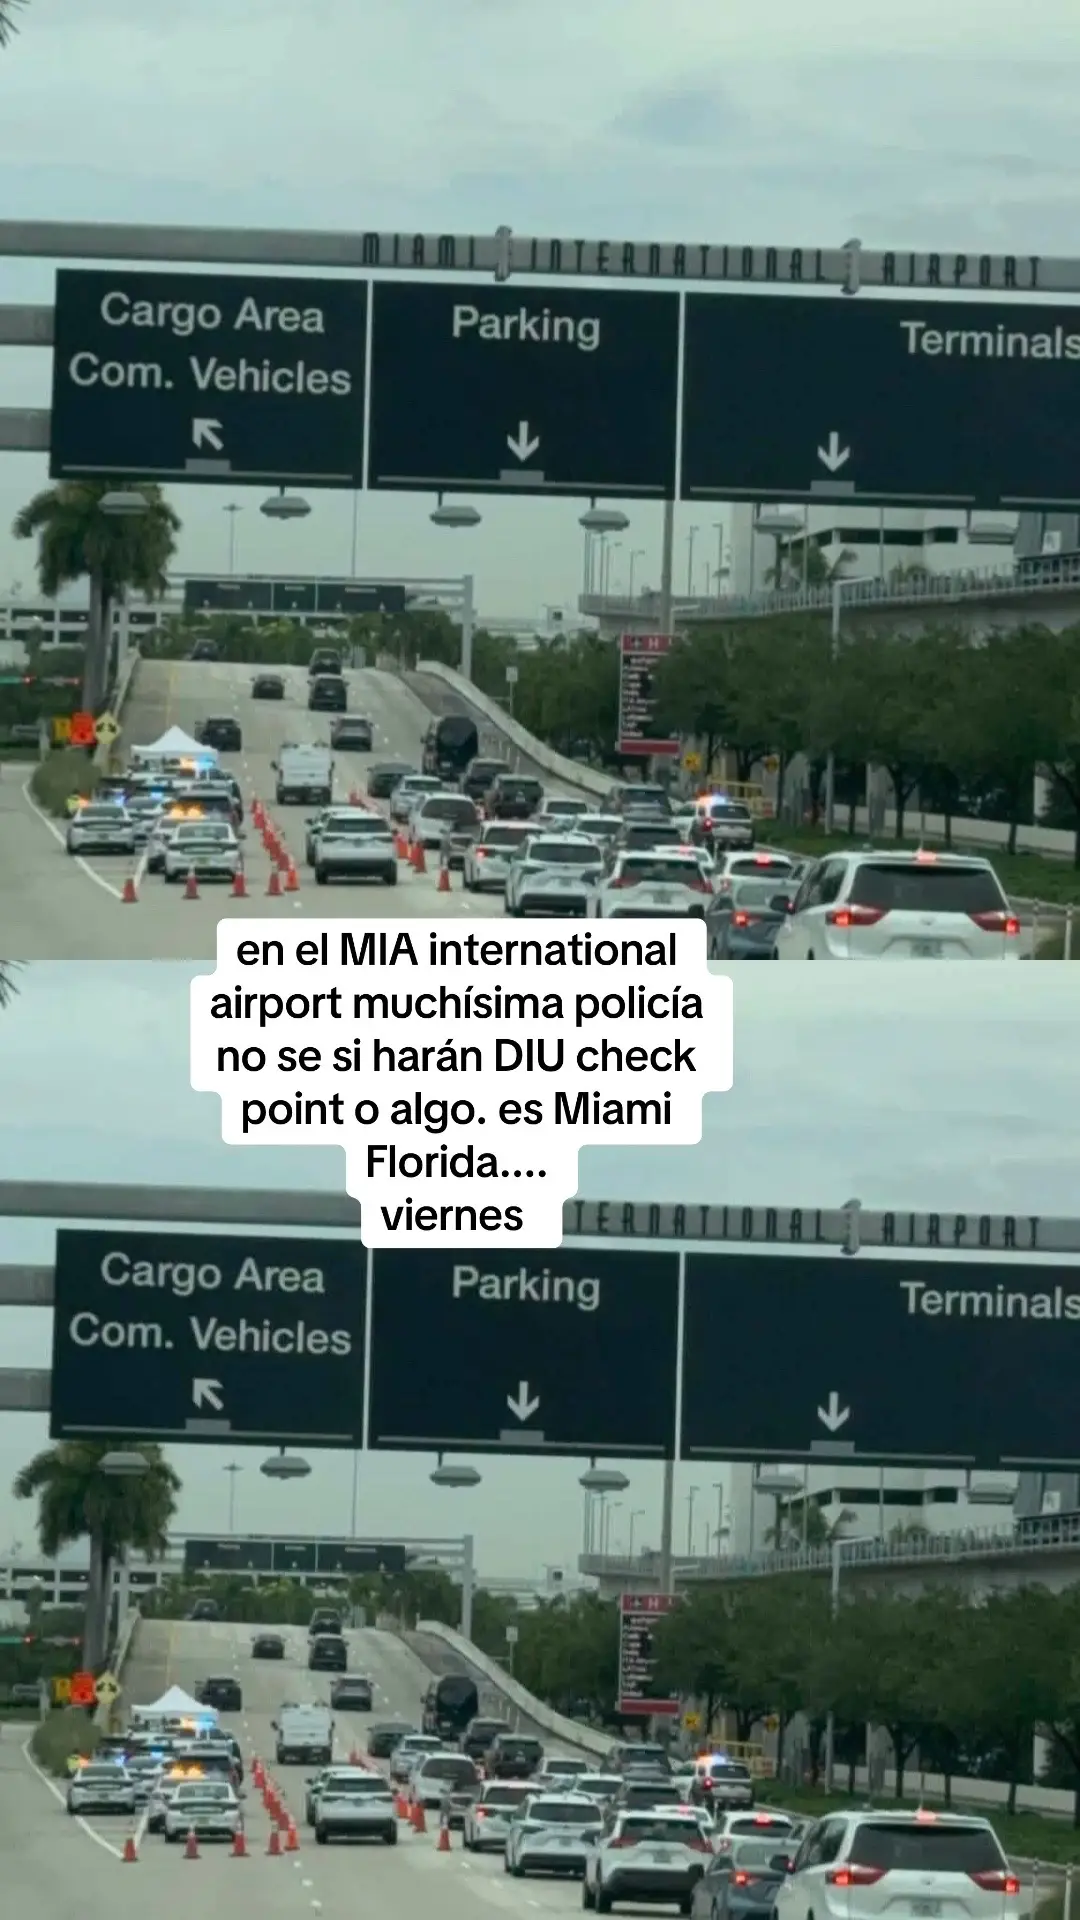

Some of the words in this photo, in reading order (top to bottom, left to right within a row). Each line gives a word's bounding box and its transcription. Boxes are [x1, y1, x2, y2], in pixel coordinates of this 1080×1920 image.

[363, 232, 475, 268] MIAMI
[531, 237, 826, 282] INTERNATIONAL
[881, 251, 1042, 287] AIRPORT
[101, 291, 222, 336] Cargo
[234, 297, 325, 333] Area
[453, 305, 601, 351] Parking
[69, 352, 173, 390] Com.
[190, 356, 352, 395] Vehicles
[574, 1198, 826, 1242] TERNATIONAL
[881, 1211, 1042, 1247] AIRPORT
[101, 1251, 222, 1296] Cargo
[234, 1257, 325, 1293] Area
[453, 1265, 601, 1311] Parking
[69, 1312, 173, 1350] Com.
[190, 1316, 352, 1355] Vehicles
